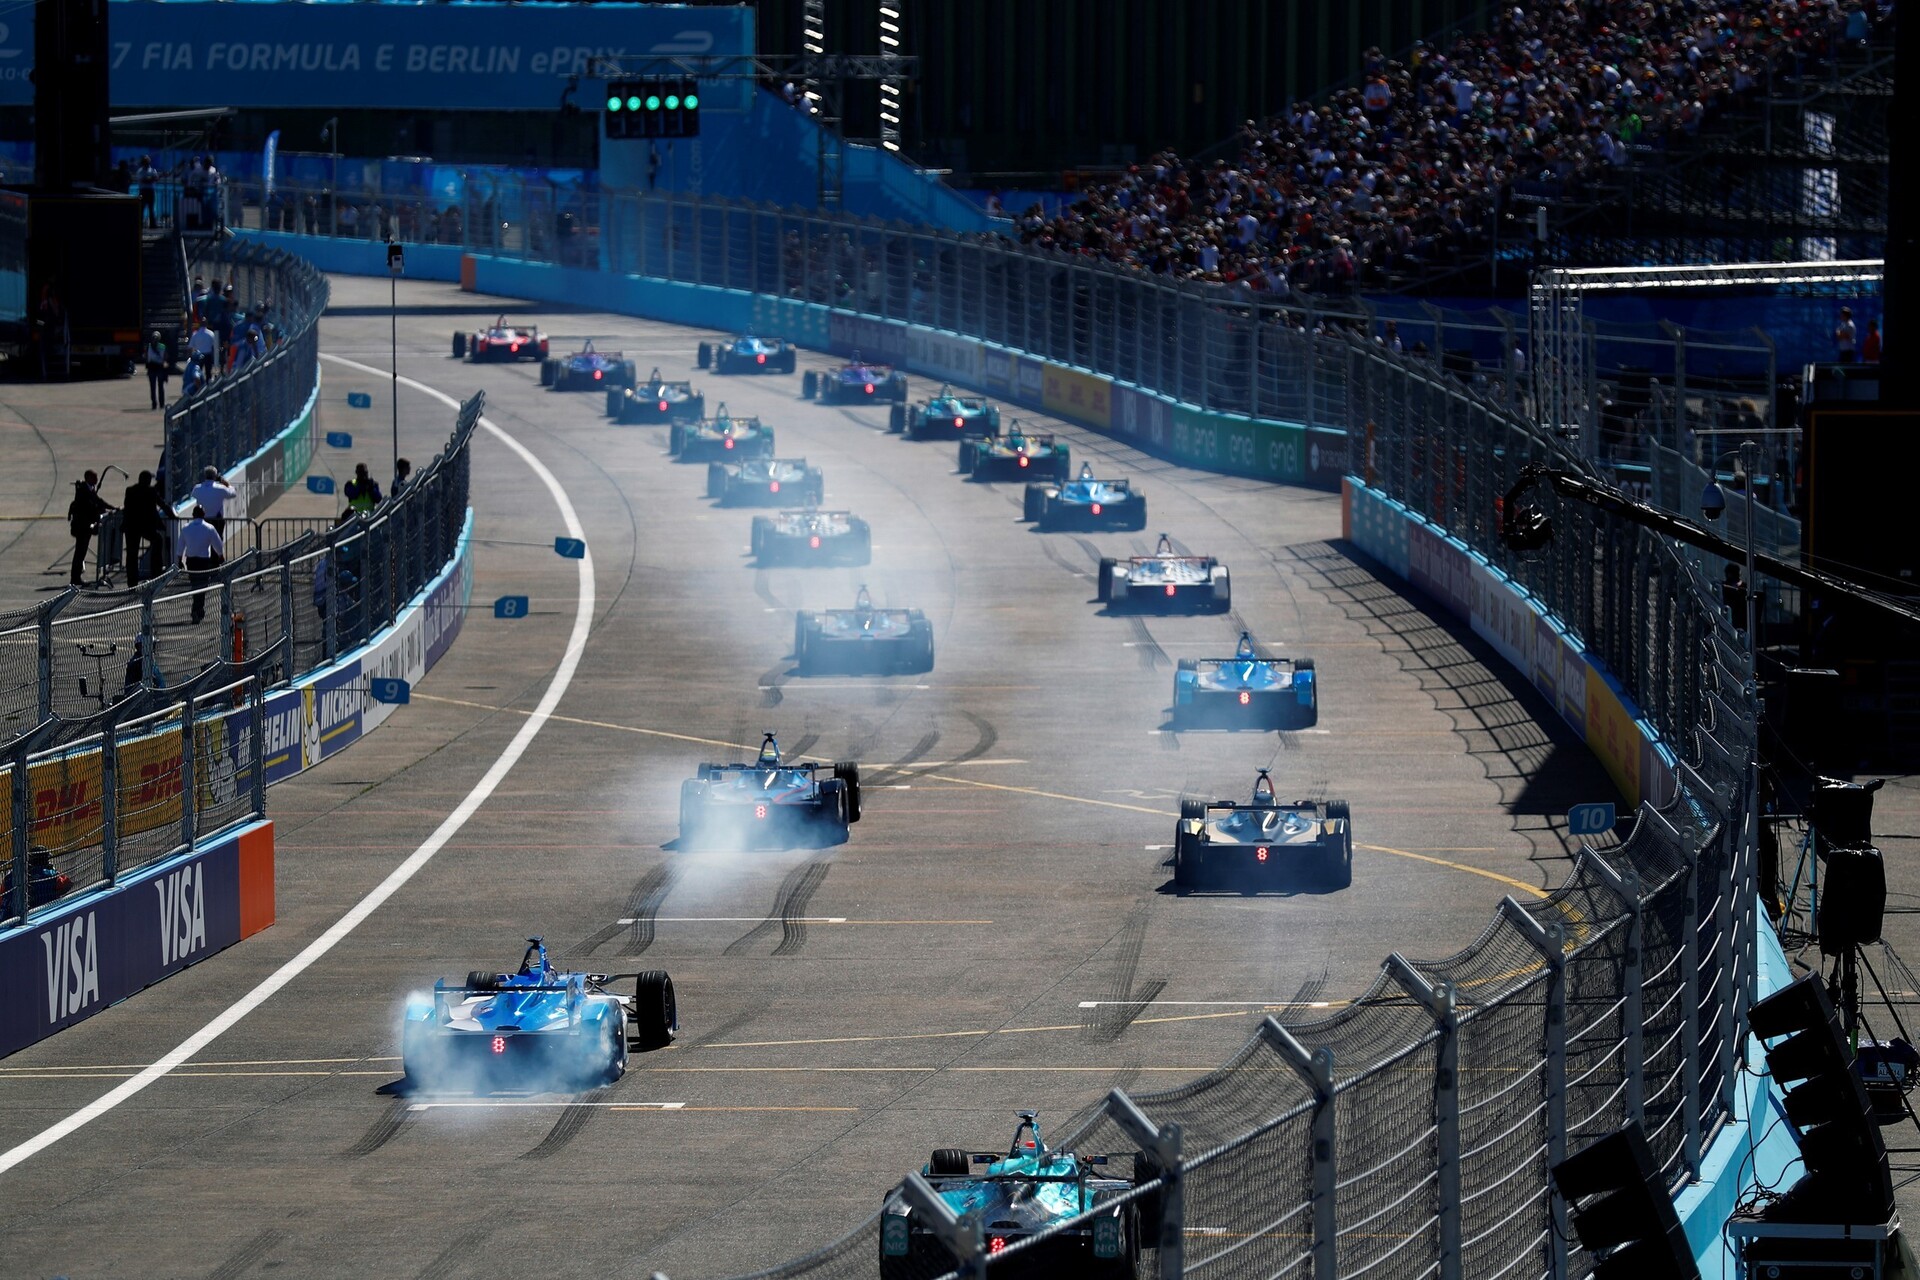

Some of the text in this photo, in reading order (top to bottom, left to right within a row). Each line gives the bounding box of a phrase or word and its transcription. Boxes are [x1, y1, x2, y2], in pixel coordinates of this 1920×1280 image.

[142, 43, 193, 70] FIA
[206, 43, 361, 72] FORMULA
[375, 44, 395, 71] E
[406, 45, 521, 74] BERLIN
[354, 395, 363, 406] 4
[335, 434, 344, 445] 5
[1230, 428, 1257, 465] enel
[1269, 435, 1298, 473] enel
[316, 479, 326, 492] 6
[565, 541, 577, 555] 7
[503, 600, 517, 616] 8
[384, 681, 399, 700] 9
[320, 676, 361, 731] MICHELIN
[1580, 809, 1606, 830] 10
[155, 861, 206, 967] VISA
[40, 911, 99, 1024] VISA
[886, 1241, 907, 1251] NIO
[1095, 1243, 1117, 1253] NIO
